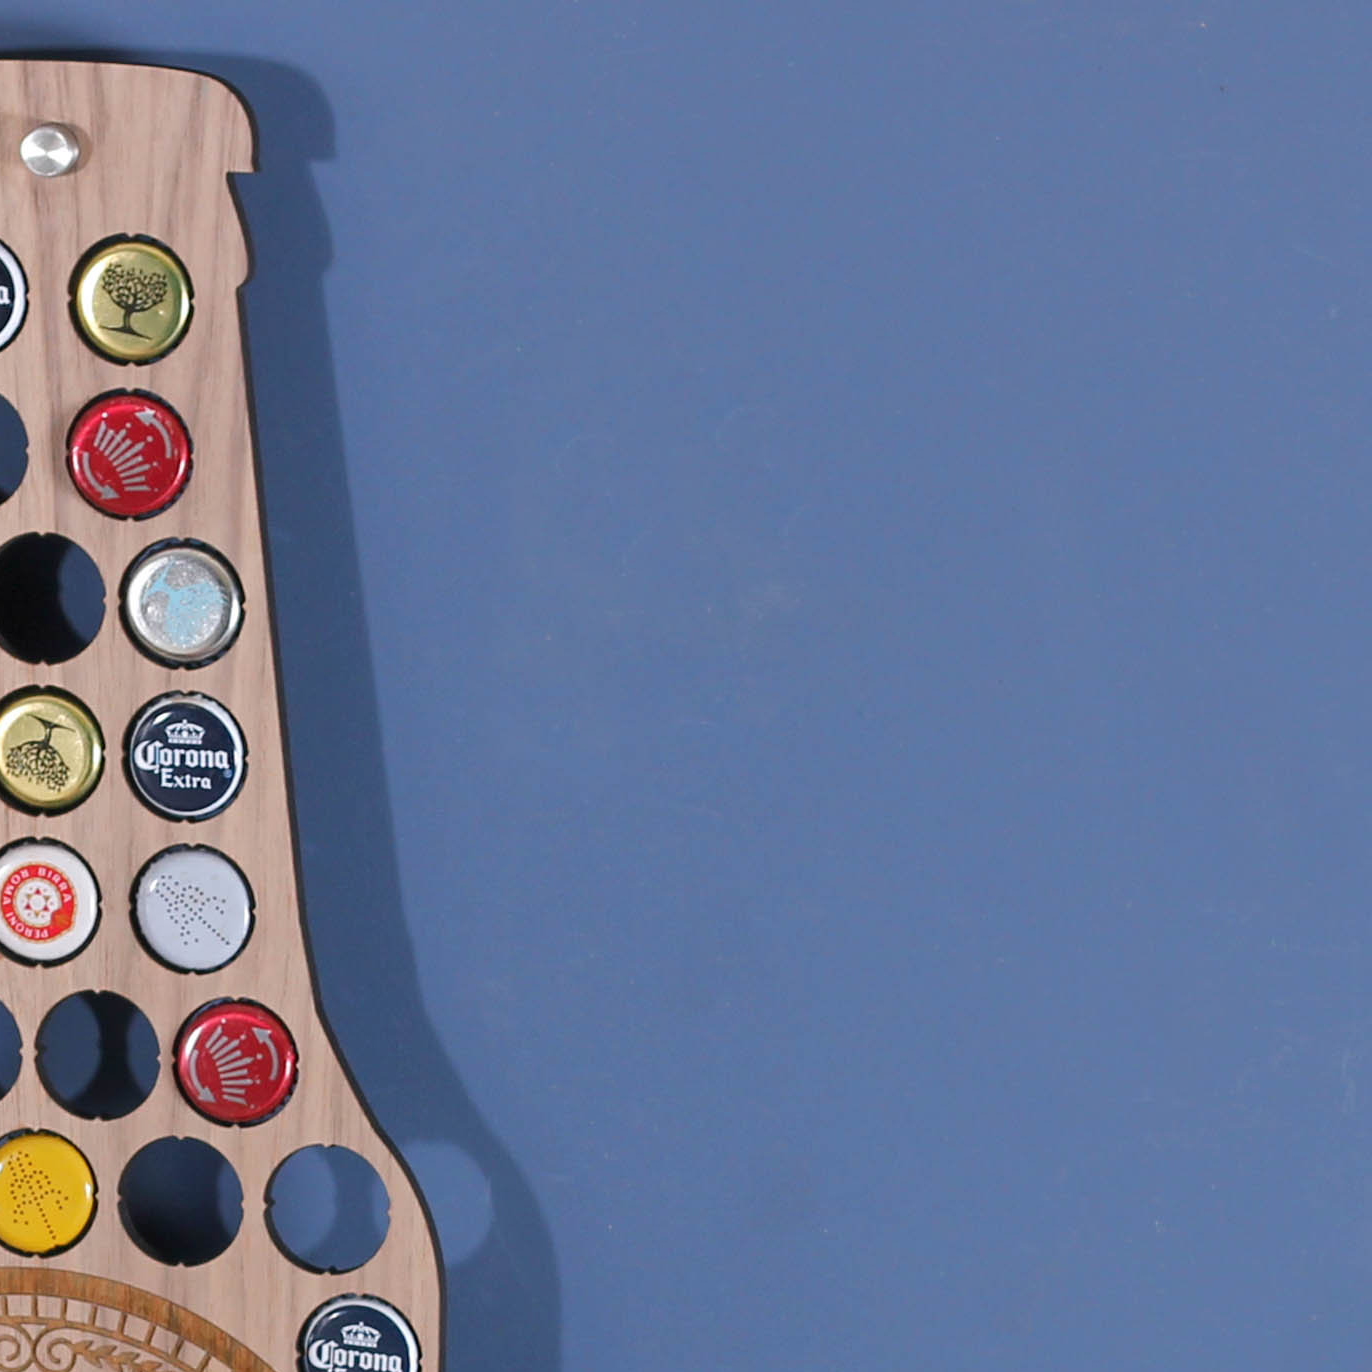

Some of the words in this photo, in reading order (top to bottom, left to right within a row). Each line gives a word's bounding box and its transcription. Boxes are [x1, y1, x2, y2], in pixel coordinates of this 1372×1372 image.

[134, 740, 230, 774] Corona
[160, 767, 212, 790] Extra
[2, 868, 30, 906] ROMA
[37, 866, 73, 904] BIRRA
[4, 910, 50, 939] PERONI
